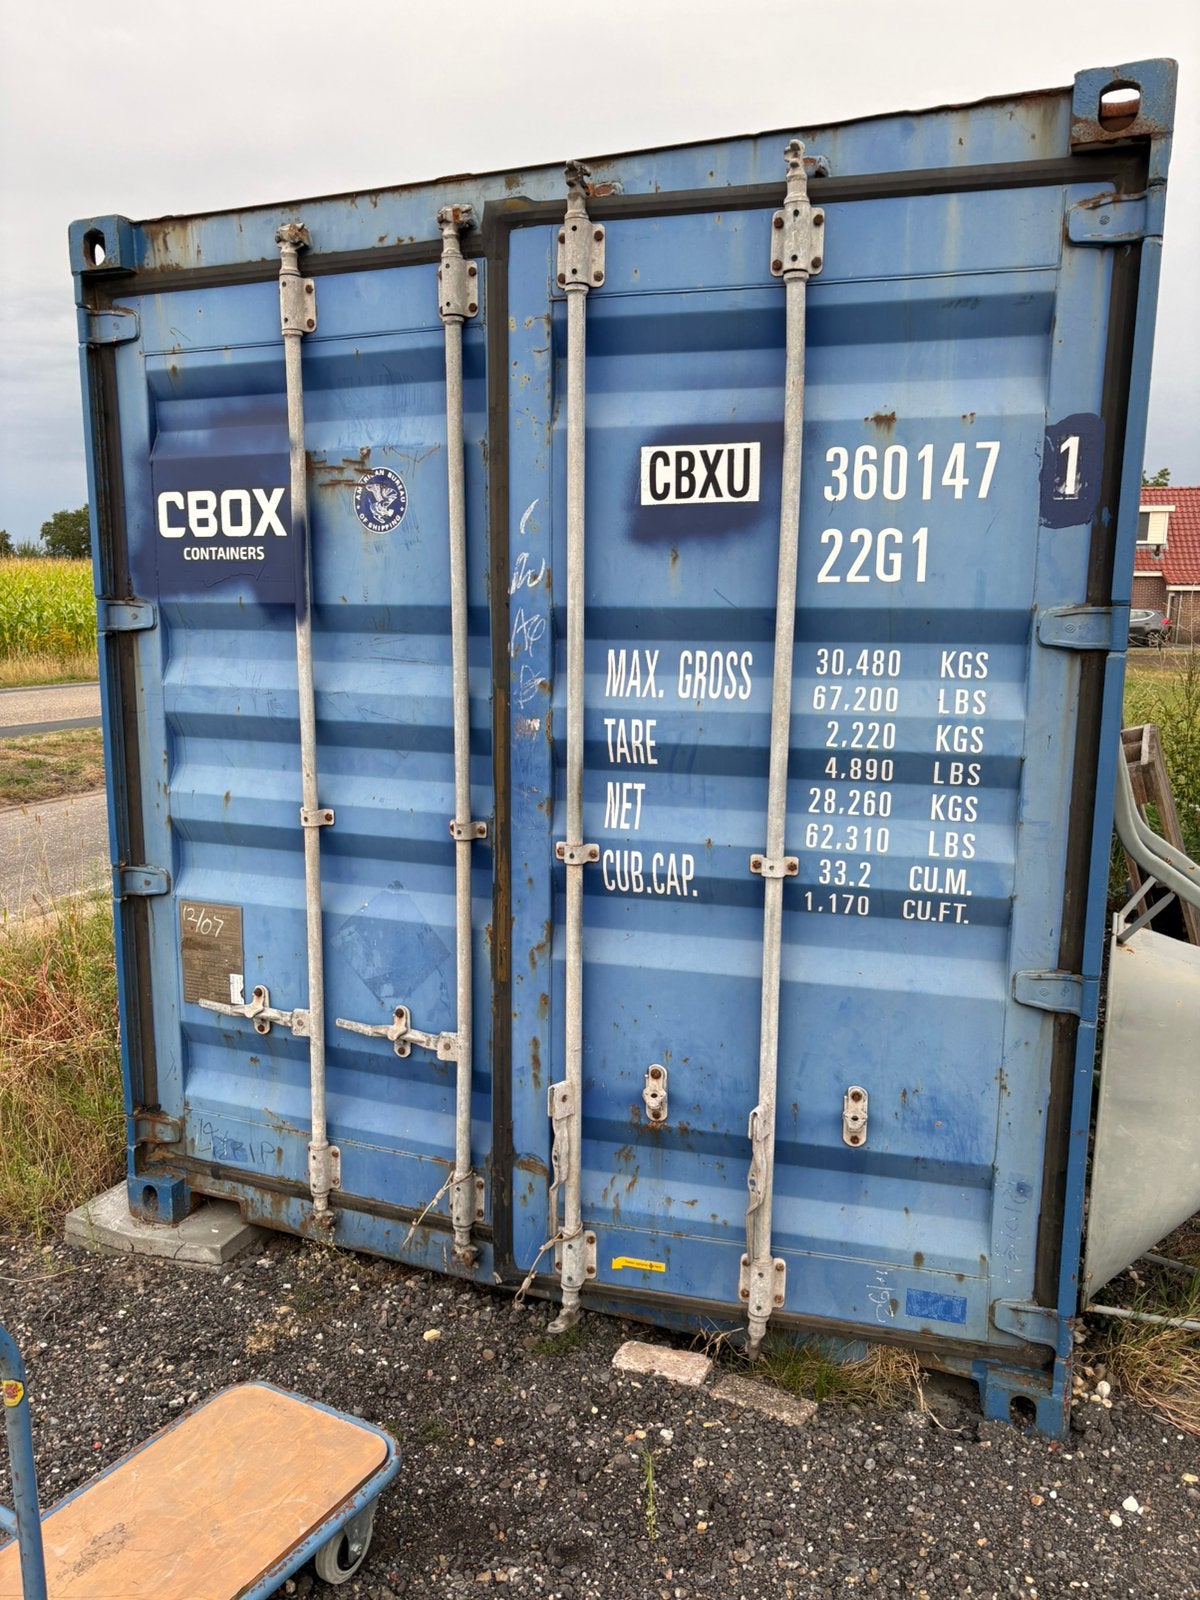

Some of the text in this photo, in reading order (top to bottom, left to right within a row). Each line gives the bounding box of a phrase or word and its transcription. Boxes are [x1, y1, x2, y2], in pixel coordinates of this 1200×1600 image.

[650, 435, 1081, 502] CBXU 360147 1
[356, 469, 406, 503] AMRIAN BUREAU
[157, 487, 288, 538] CBOX
[359, 513, 401, 532] OF SHIPPING
[183, 546, 265, 560] CONTAINERS
[817, 527, 929, 583] 22G1
[605, 649, 665, 698] MAX.
[678, 650, 753, 700] GROSS
[940, 650, 989, 680] KGS
[937, 688, 987, 716] LBS
[604, 718, 658, 765] TARE
[935, 724, 985, 754] KGS
[933, 761, 982, 786] LBS
[604, 781, 646, 830] NET
[930, 794, 978, 823] KGS
[928, 830, 976, 859] LBS
[602, 849, 973, 897] CUB.CAP. 33.2 CU.M.
[182, 905, 224, 938] 12/07
[902, 899, 970, 925] CU.FT.
